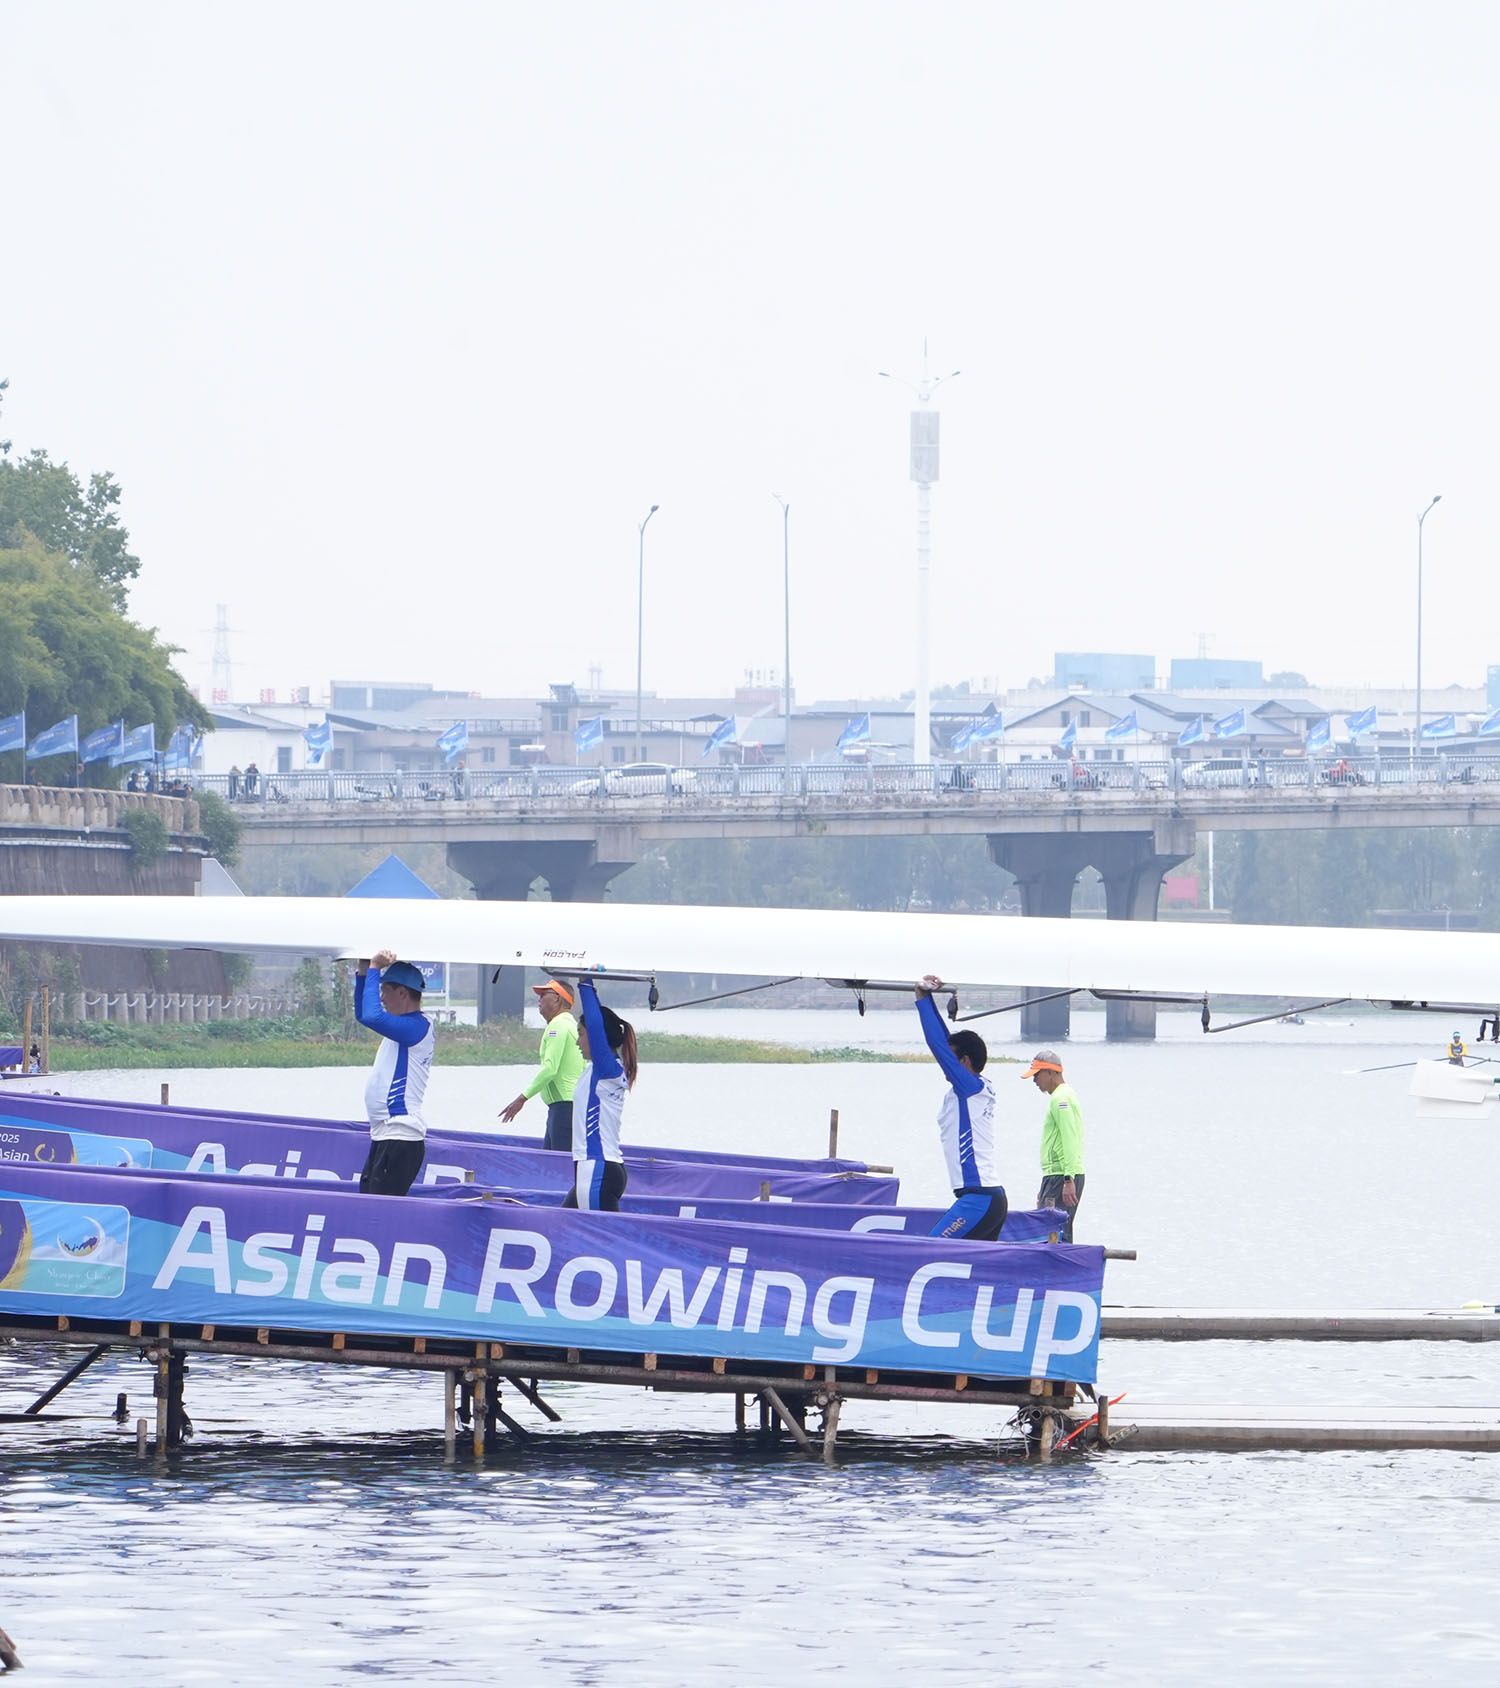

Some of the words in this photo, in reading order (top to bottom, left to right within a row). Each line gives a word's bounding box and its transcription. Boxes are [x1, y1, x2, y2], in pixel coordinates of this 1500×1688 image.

[543, 951, 586, 959] FALCON
[0, 1133, 20, 1144] 025
[151, 1205, 448, 1310] Asian
[474, 1228, 875, 1363] Rowing
[901, 1262, 1098, 1377] Cup
